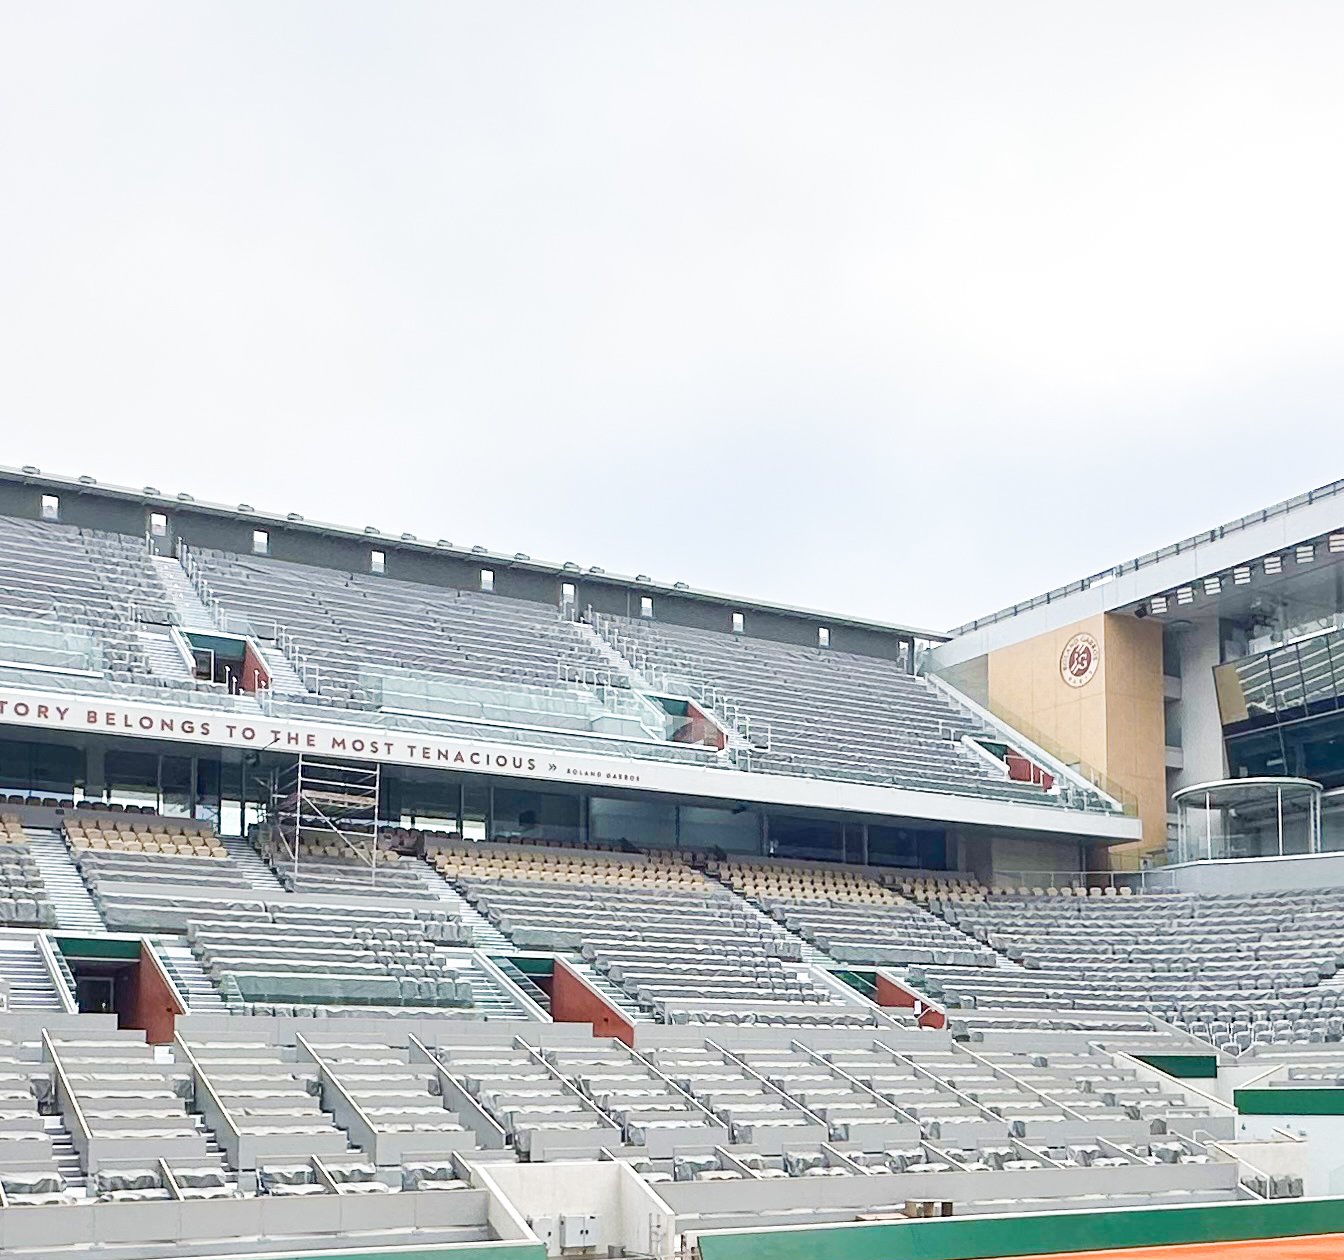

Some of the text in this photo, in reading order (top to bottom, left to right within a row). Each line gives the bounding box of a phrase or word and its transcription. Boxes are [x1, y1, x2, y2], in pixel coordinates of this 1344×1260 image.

[86, 710, 210, 736] BELONGS
[226, 725, 256, 741] TO
[270, 730, 316, 747] THE
[331, 736, 394, 755] MOST
[407, 745, 536, 770] TENACIOUS
[566, 768, 602, 778] ROLAND
